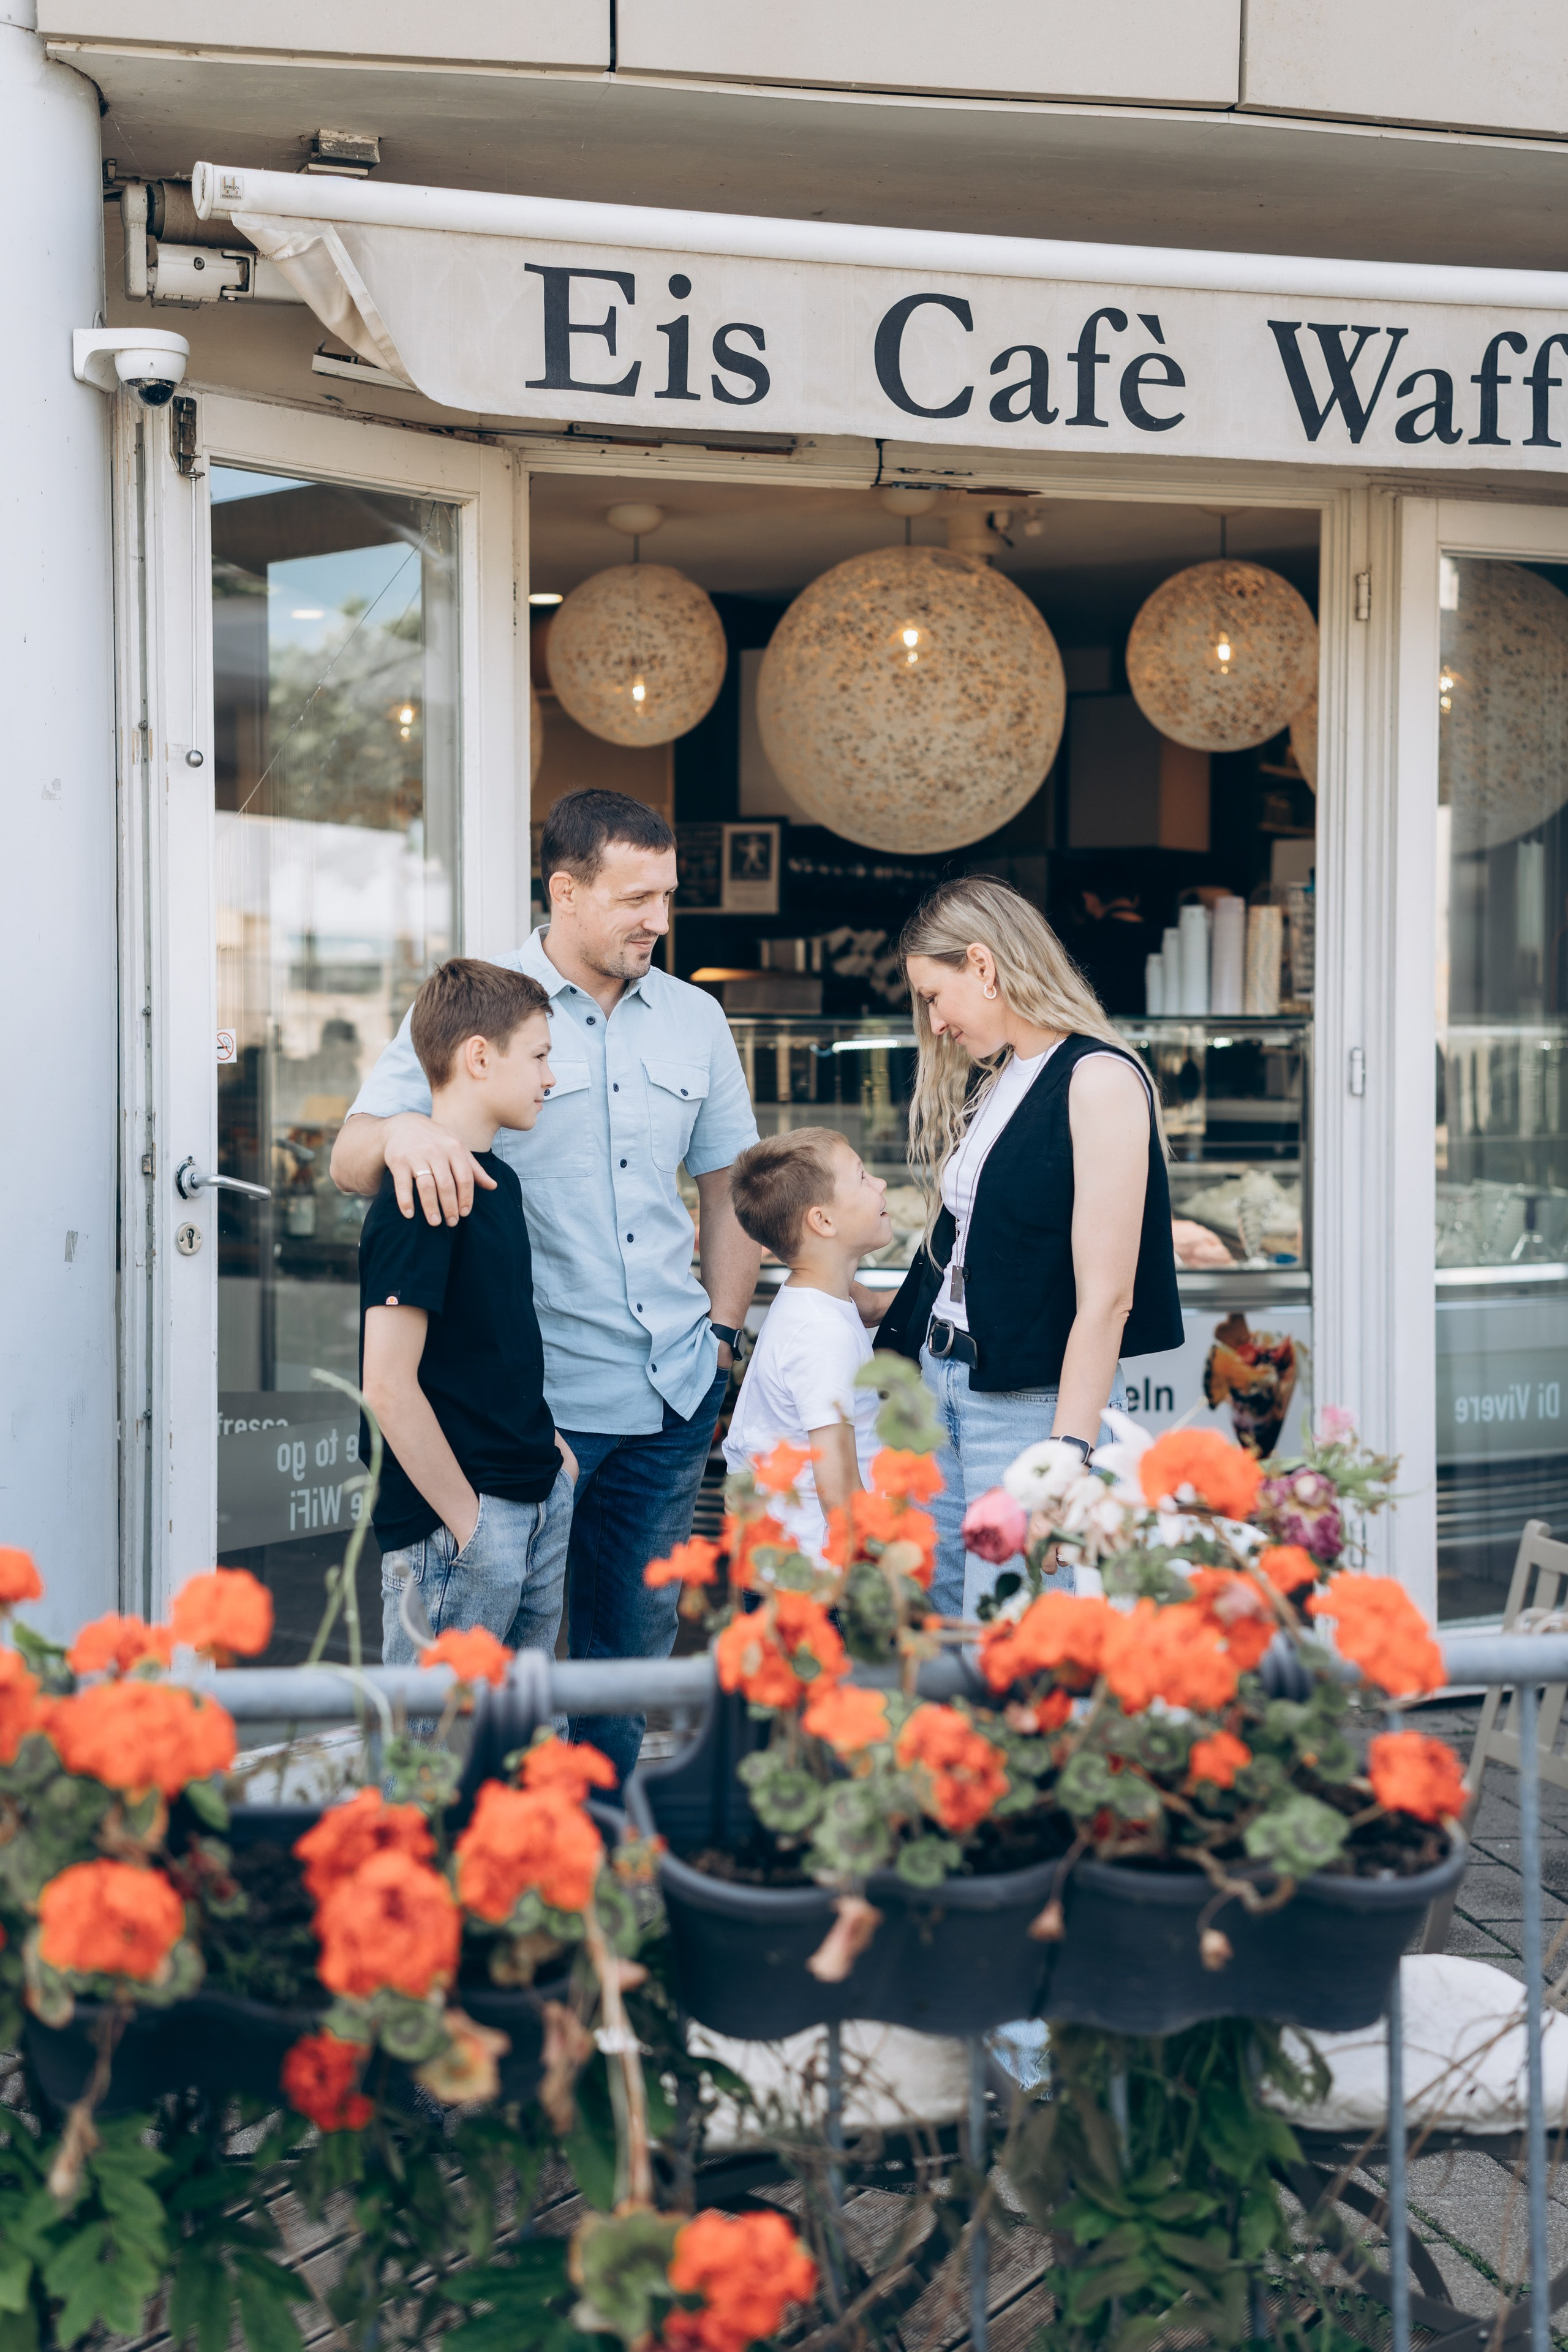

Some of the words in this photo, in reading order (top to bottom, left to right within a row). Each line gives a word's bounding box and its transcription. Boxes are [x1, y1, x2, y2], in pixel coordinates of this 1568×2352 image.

[524, 263, 771, 405] Eis
[874, 293, 1186, 432] Cafè
[1267, 320, 1568, 448] Waff
